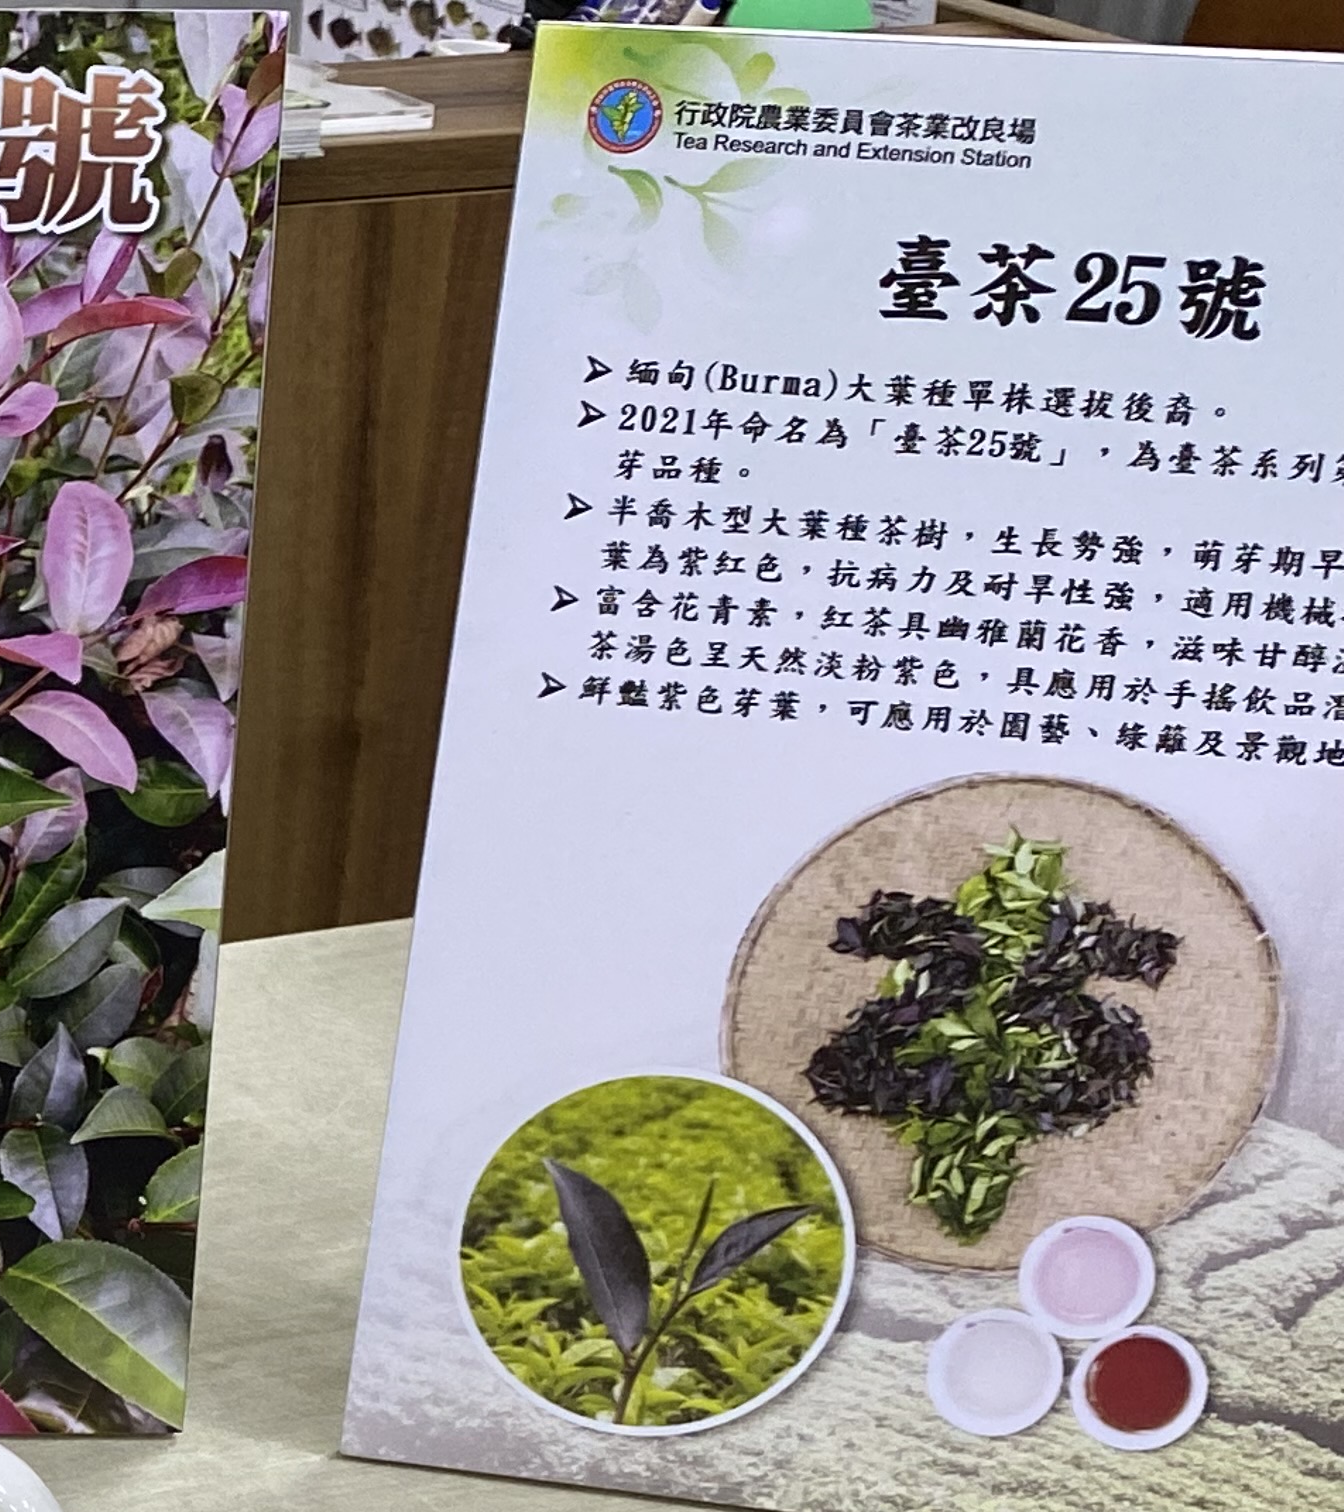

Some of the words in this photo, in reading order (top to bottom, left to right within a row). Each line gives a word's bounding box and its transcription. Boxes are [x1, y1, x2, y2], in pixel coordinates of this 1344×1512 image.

[674, 99, 1036, 145] 行政院農業委員會茶業改良場
[674, 131, 708, 151] Tea
[713, 134, 809, 159] Research
[813, 142, 850, 161] and
[856, 143, 956, 166] Extension
[961, 149, 1032, 170] Station
[878, 234, 1268, 341] 臺茶25號
[625, 357, 1228, 427] 緬甸(Burma)大葉種單株選拔後裔。
[614, 449, 751, 485] 芽品種。
[607, 494, 1344, 580] 半喬木型大葉種茶樹，生長勢強，萌芽期早
[600, 540, 1344, 630] 葉為紫紅色，抗病力及耐旱性強，適用機械
